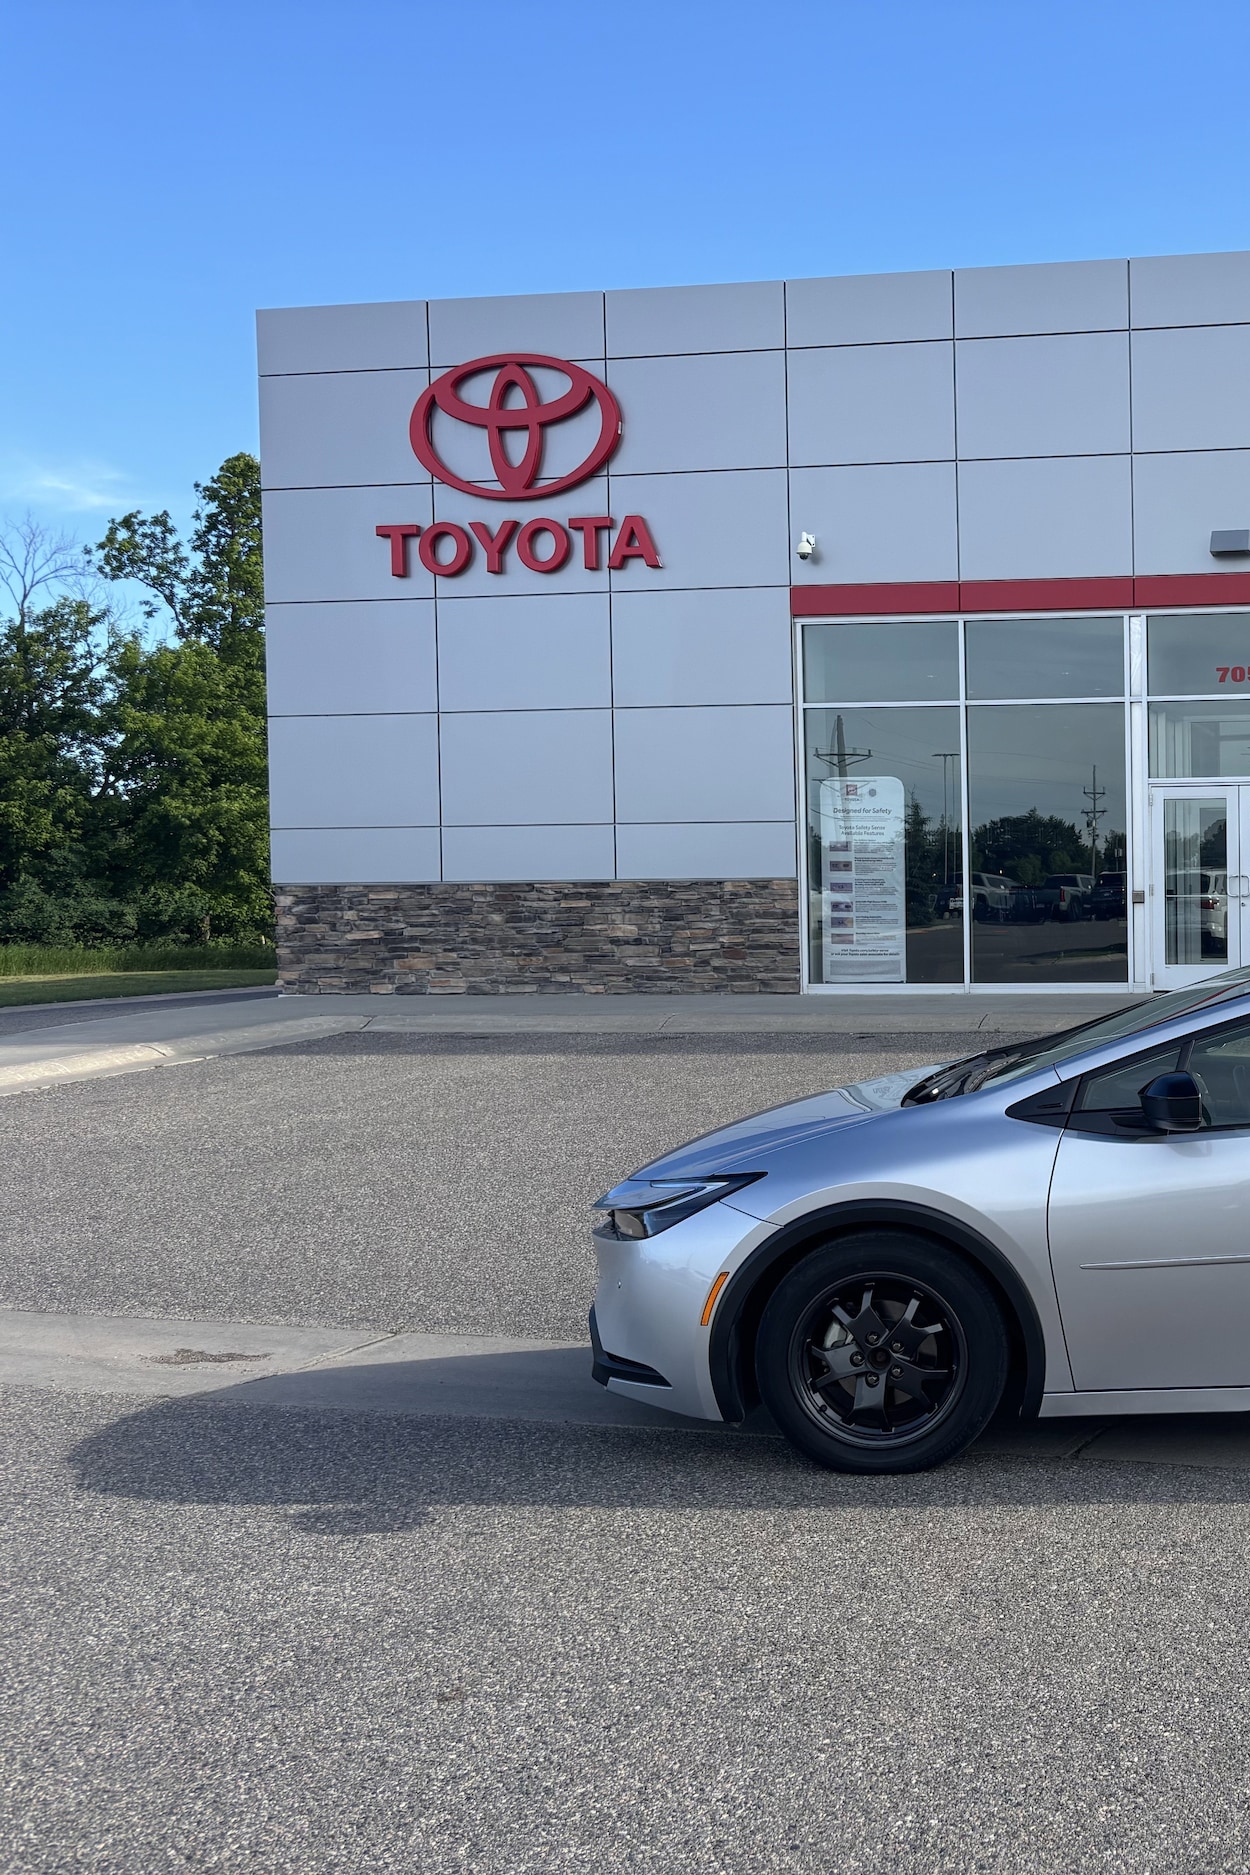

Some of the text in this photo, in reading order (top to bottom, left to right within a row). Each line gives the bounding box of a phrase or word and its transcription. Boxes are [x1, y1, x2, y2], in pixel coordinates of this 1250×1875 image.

[376, 515, 662, 578] TOYOTA
[832, 807, 862, 815] Designed
[872, 807, 892, 815] Safety
